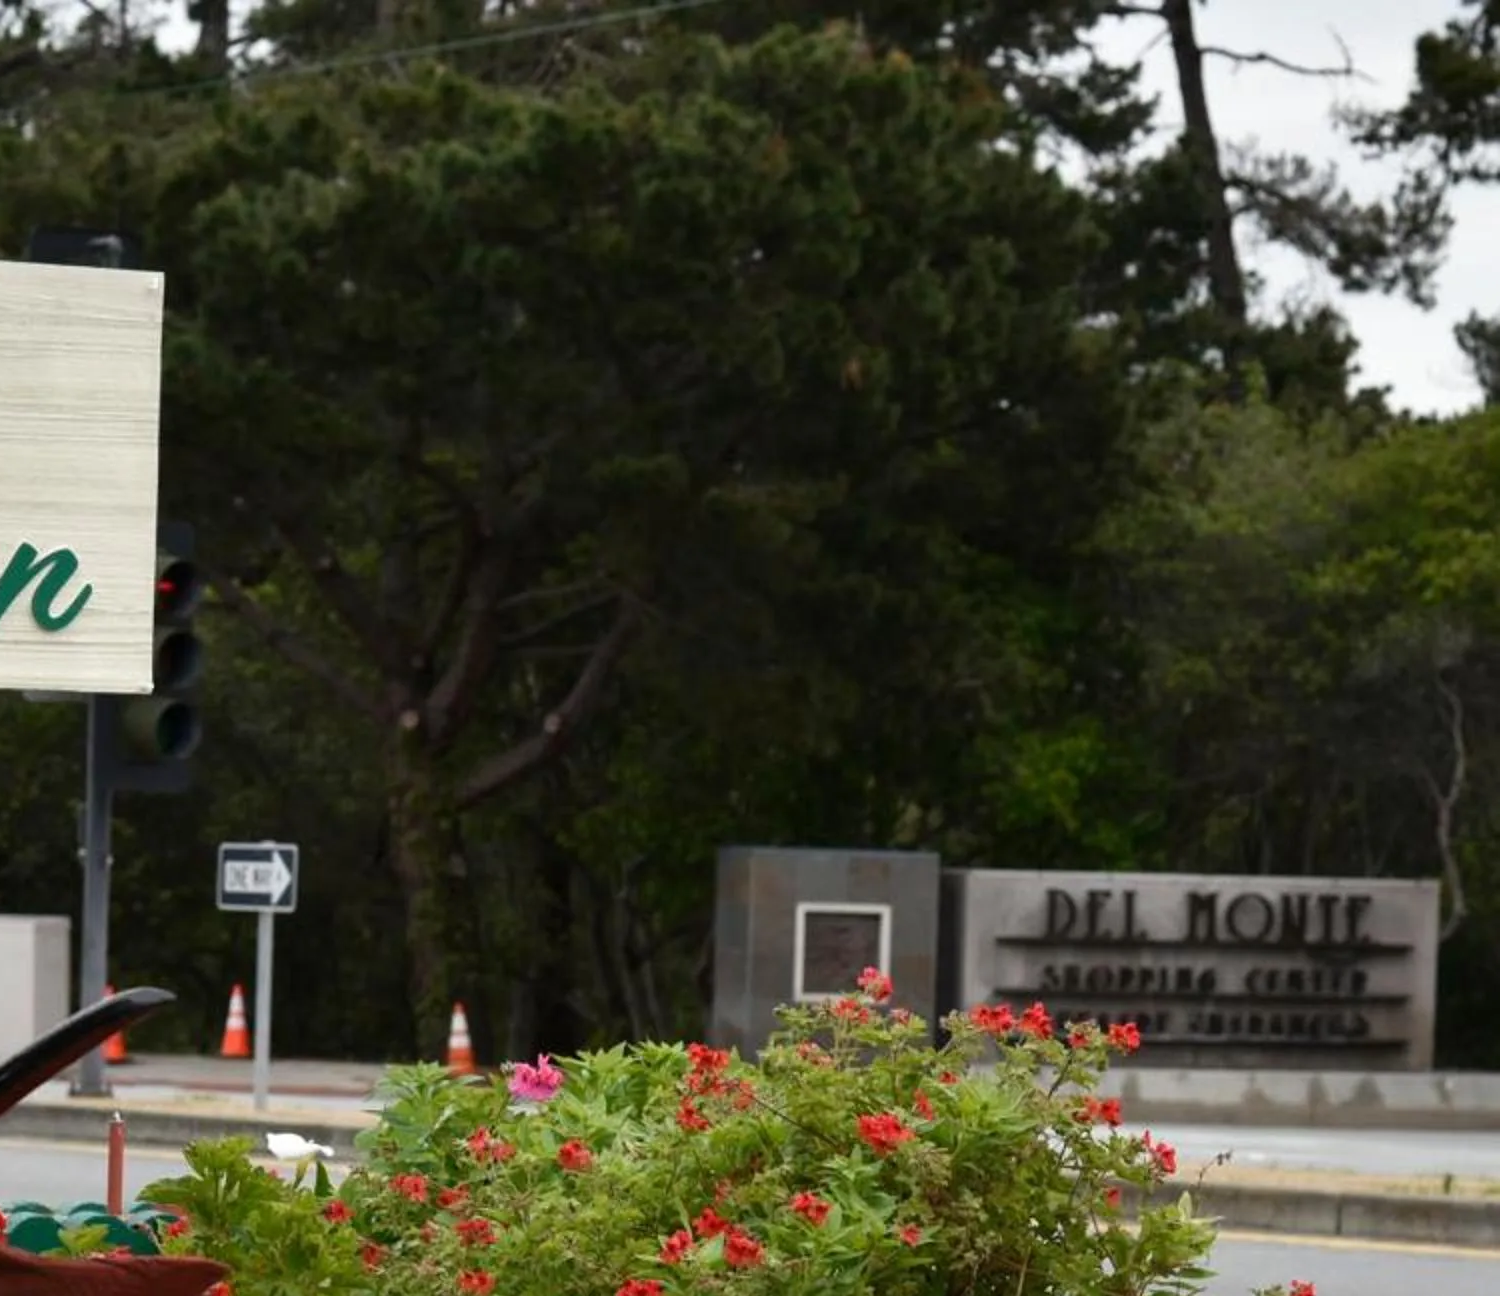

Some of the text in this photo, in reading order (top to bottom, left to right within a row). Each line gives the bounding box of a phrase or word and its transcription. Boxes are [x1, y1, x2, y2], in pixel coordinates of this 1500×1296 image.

[1046, 888, 1373, 945] DEL MONTE
[1040, 964, 1369, 996] SHOPPING CENTER
